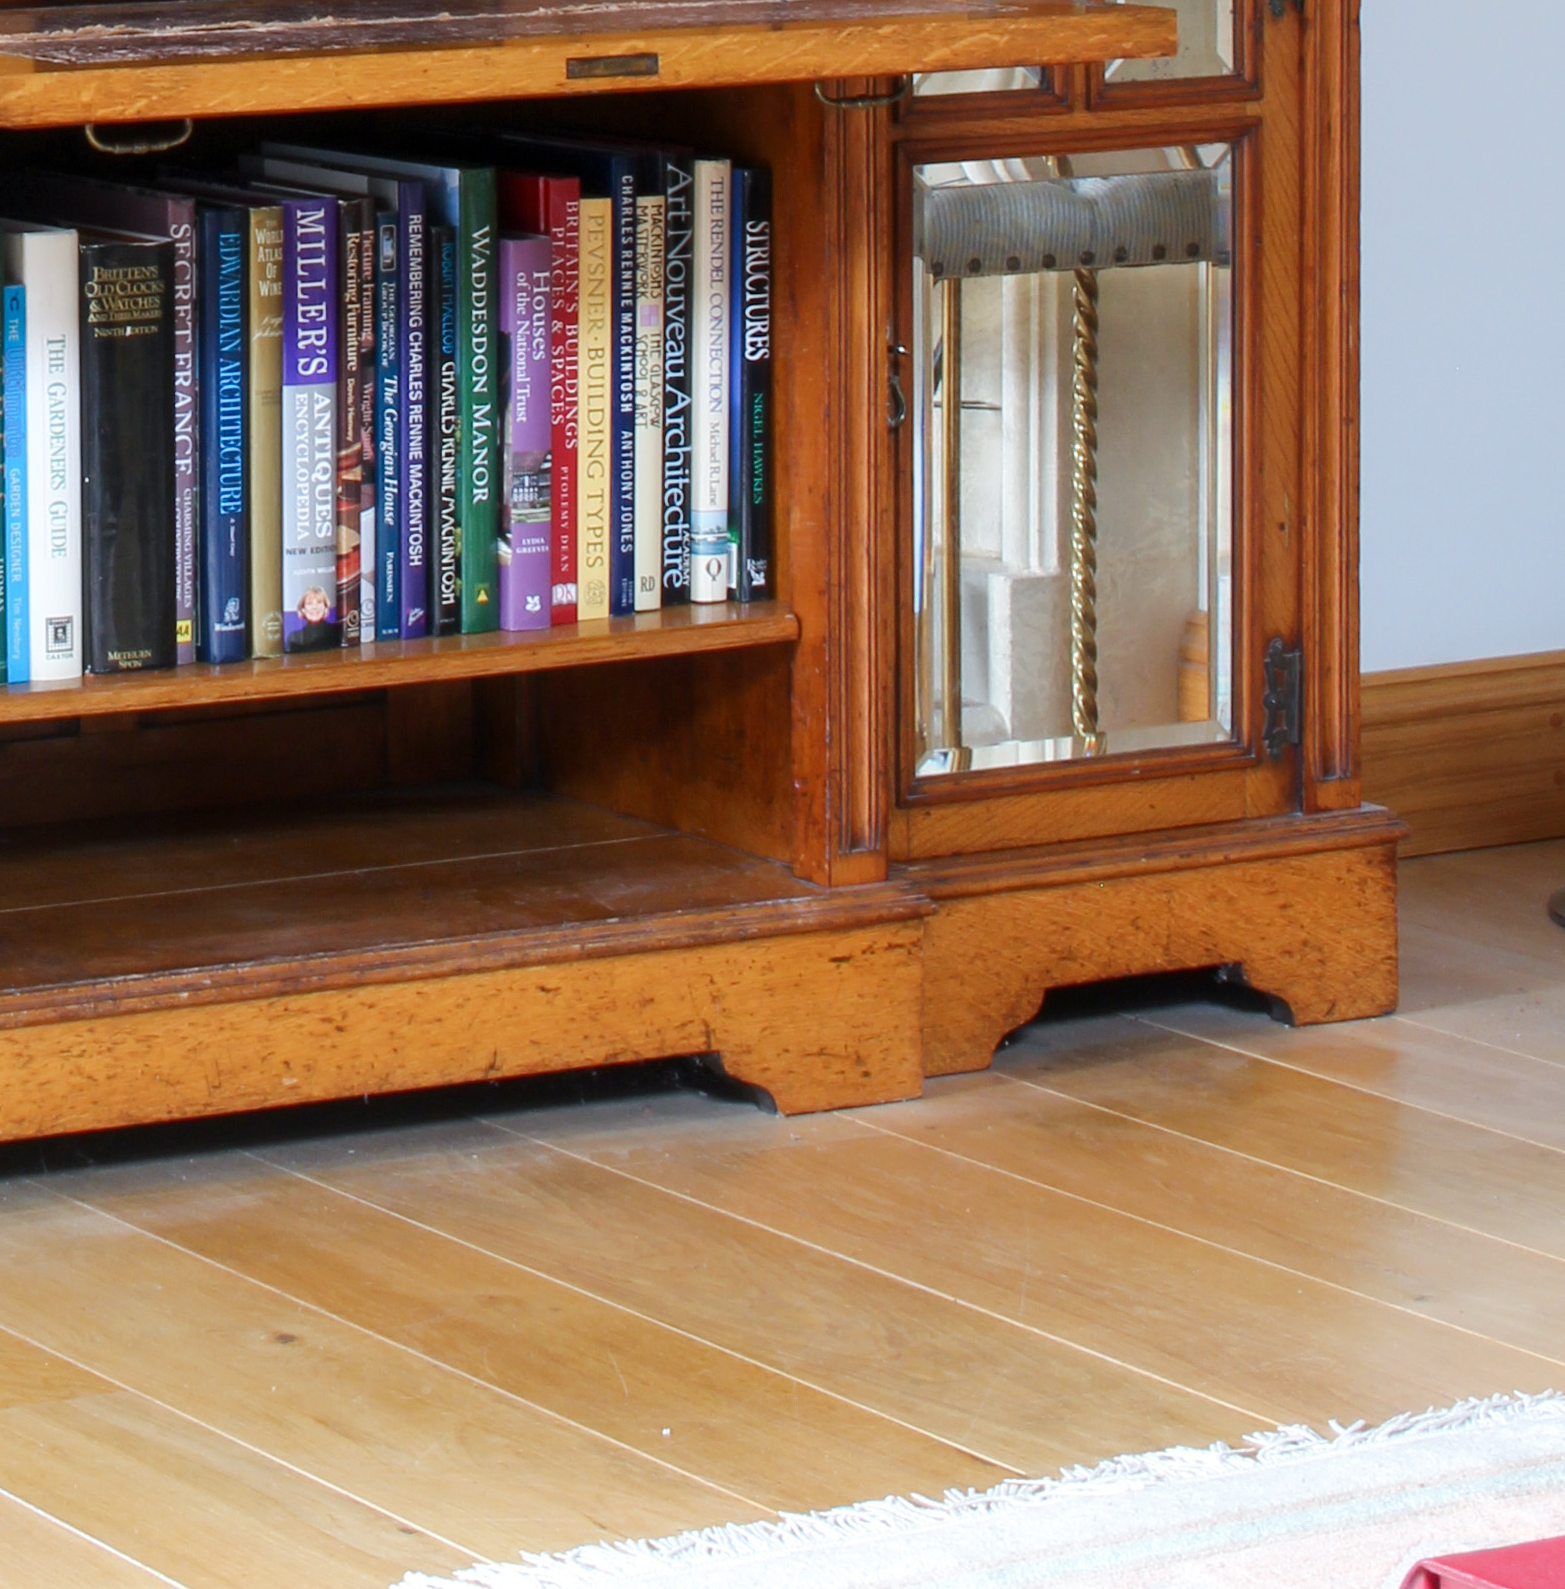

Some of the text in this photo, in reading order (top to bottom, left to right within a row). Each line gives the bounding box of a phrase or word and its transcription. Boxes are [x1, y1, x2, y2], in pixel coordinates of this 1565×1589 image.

[169, 224, 192, 344] SECRET
[296, 207, 328, 377] MILLER'S
[344, 231, 361, 303] Restoring
[346, 304, 361, 373] Furniture
[361, 229, 375, 342] Picture Framing
[532, 271, 550, 362] Houses
[550, 227, 565, 426] PLACES & SPACES
[565, 201, 579, 450] BRITAIN'S BUILDINGS
[708, 176, 726, 414] THE RENDEL CONNECTION
[219, 233, 242, 516] EDWARDIAN ARCHITECTURE
[408, 214, 423, 567] REMEMBERING CHARLES RENNIE MACKINTOSH
[471, 225, 491, 505] WADDESDON MANOR
[516, 272, 532, 423] of the National Trust
[586, 214, 607, 569] PEVSNER BUILDING TYPES
[620, 175, 634, 553] CHARLES RENNIE MACKINTOSH ANTHONY JONES
[634, 403, 648, 430] ART
[650, 332, 662, 358] THE
[664, 162, 693, 589] Art Nouveau Architecture
[744, 220, 771, 505] STRUCTURES NIGEL HAWKES
[8, 318, 23, 583] THE GARDEN DESIGNER
[47, 334, 68, 560] THE GARDENERS GUIDE
[295, 392, 310, 541] ENCYCLOPEDIA
[310, 392, 332, 539] ANTIQUES
[379, 374, 400, 526] The Georgian House
[441, 361, 456, 606] CHARLES RENNIE MACKINTOSH
[560, 465, 569, 573] PTOLEMY DEAN
[184, 488, 193, 608] CHARMING VILLAGES
[285, 546, 307, 556] NEW
[552, 583, 578, 605] DK
